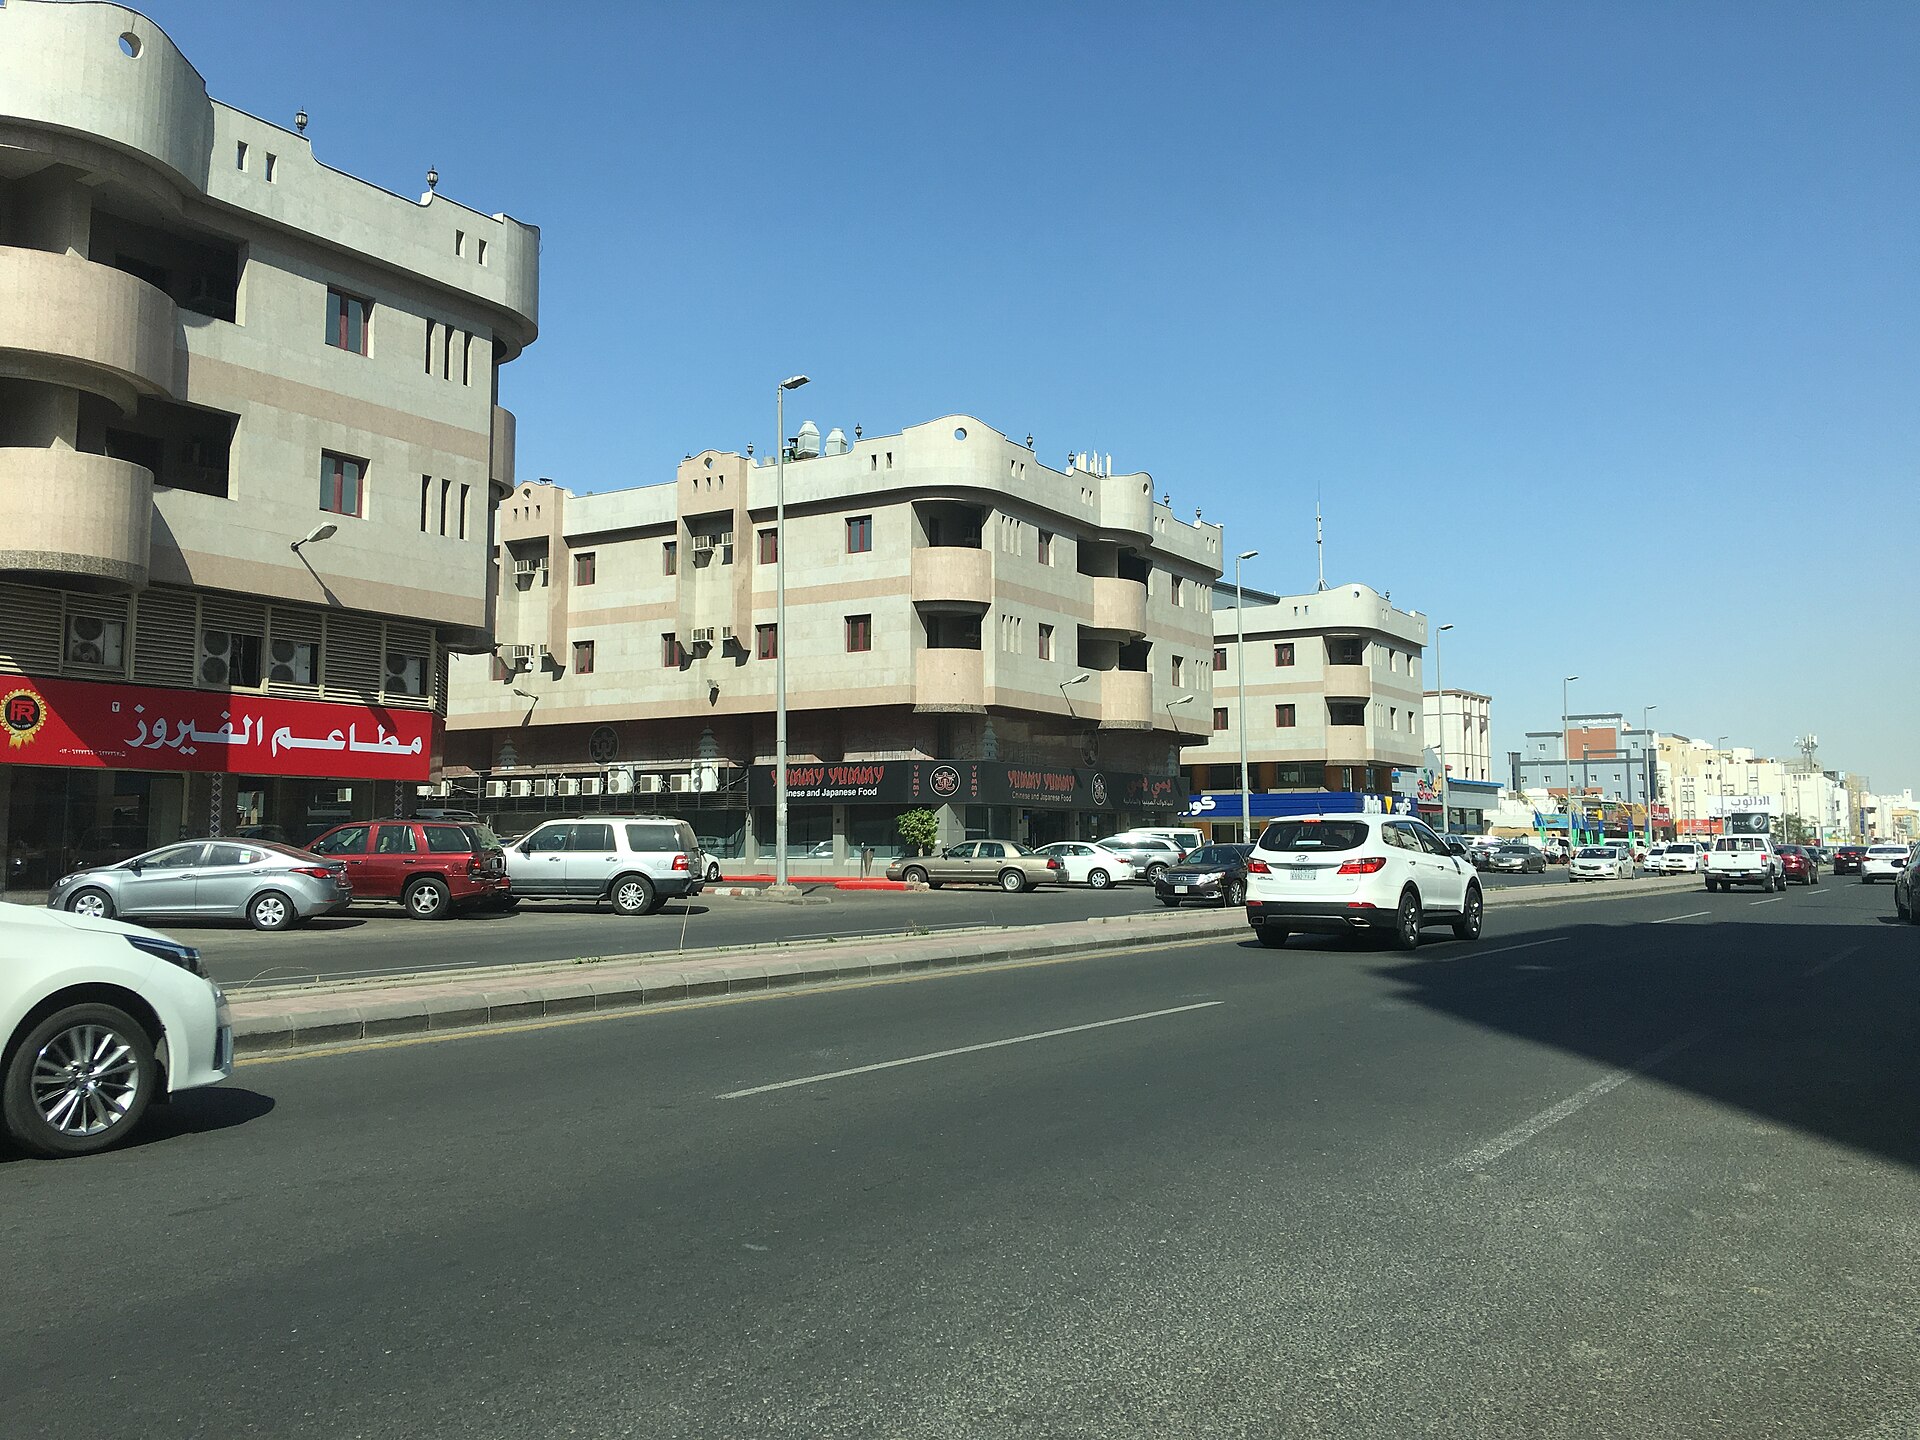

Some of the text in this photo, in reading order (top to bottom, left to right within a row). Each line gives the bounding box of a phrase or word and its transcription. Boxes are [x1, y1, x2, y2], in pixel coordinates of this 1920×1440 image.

[124, 704, 423, 758] مطاعم الفيروز
[828, 765, 885, 786] YUMMY
[1008, 770, 1076, 793] YUMMY YUMMY
[806, 788, 821, 797] and
[821, 787, 857, 799] Japanese
[858, 786, 878, 796] Food
[1012, 790, 1072, 803] Chinese and Japanese Food
[1731, 796, 1770, 808] الدانوب
